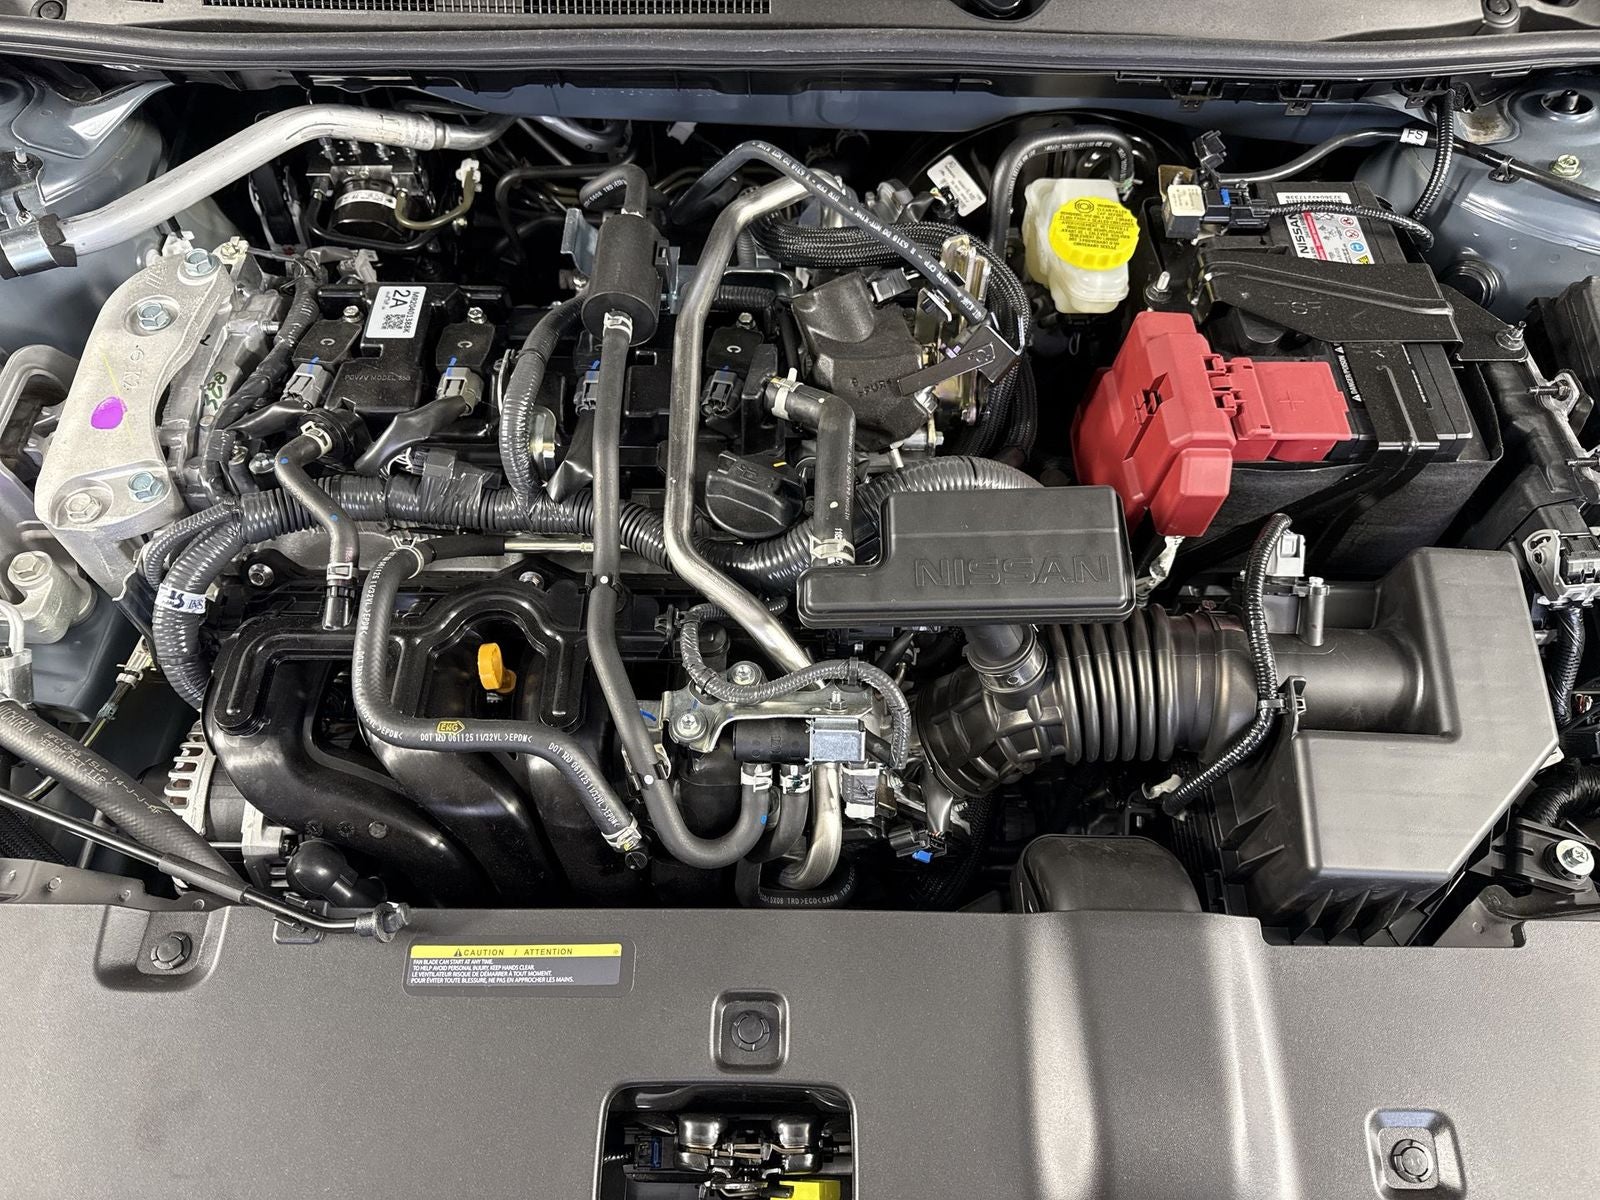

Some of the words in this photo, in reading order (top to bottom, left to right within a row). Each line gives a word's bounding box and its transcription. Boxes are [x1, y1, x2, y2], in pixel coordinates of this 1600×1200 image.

[1407, 130, 1424, 140] FS
[389, 289, 411, 308] 2A
[914, 555, 1111, 587] NISSAN
[420, 733, 433, 742] DOT
[448, 733, 474, 742] 061125
[475, 733, 502, 742] 11/32VL
[504, 733, 533, 743] >EPDM<
[548, 742, 563, 755] DOT
[571, 761, 590, 785] 061125
[601, 805, 621, 828] >EPDM<
[524, 948, 573, 956] ATTENTION
